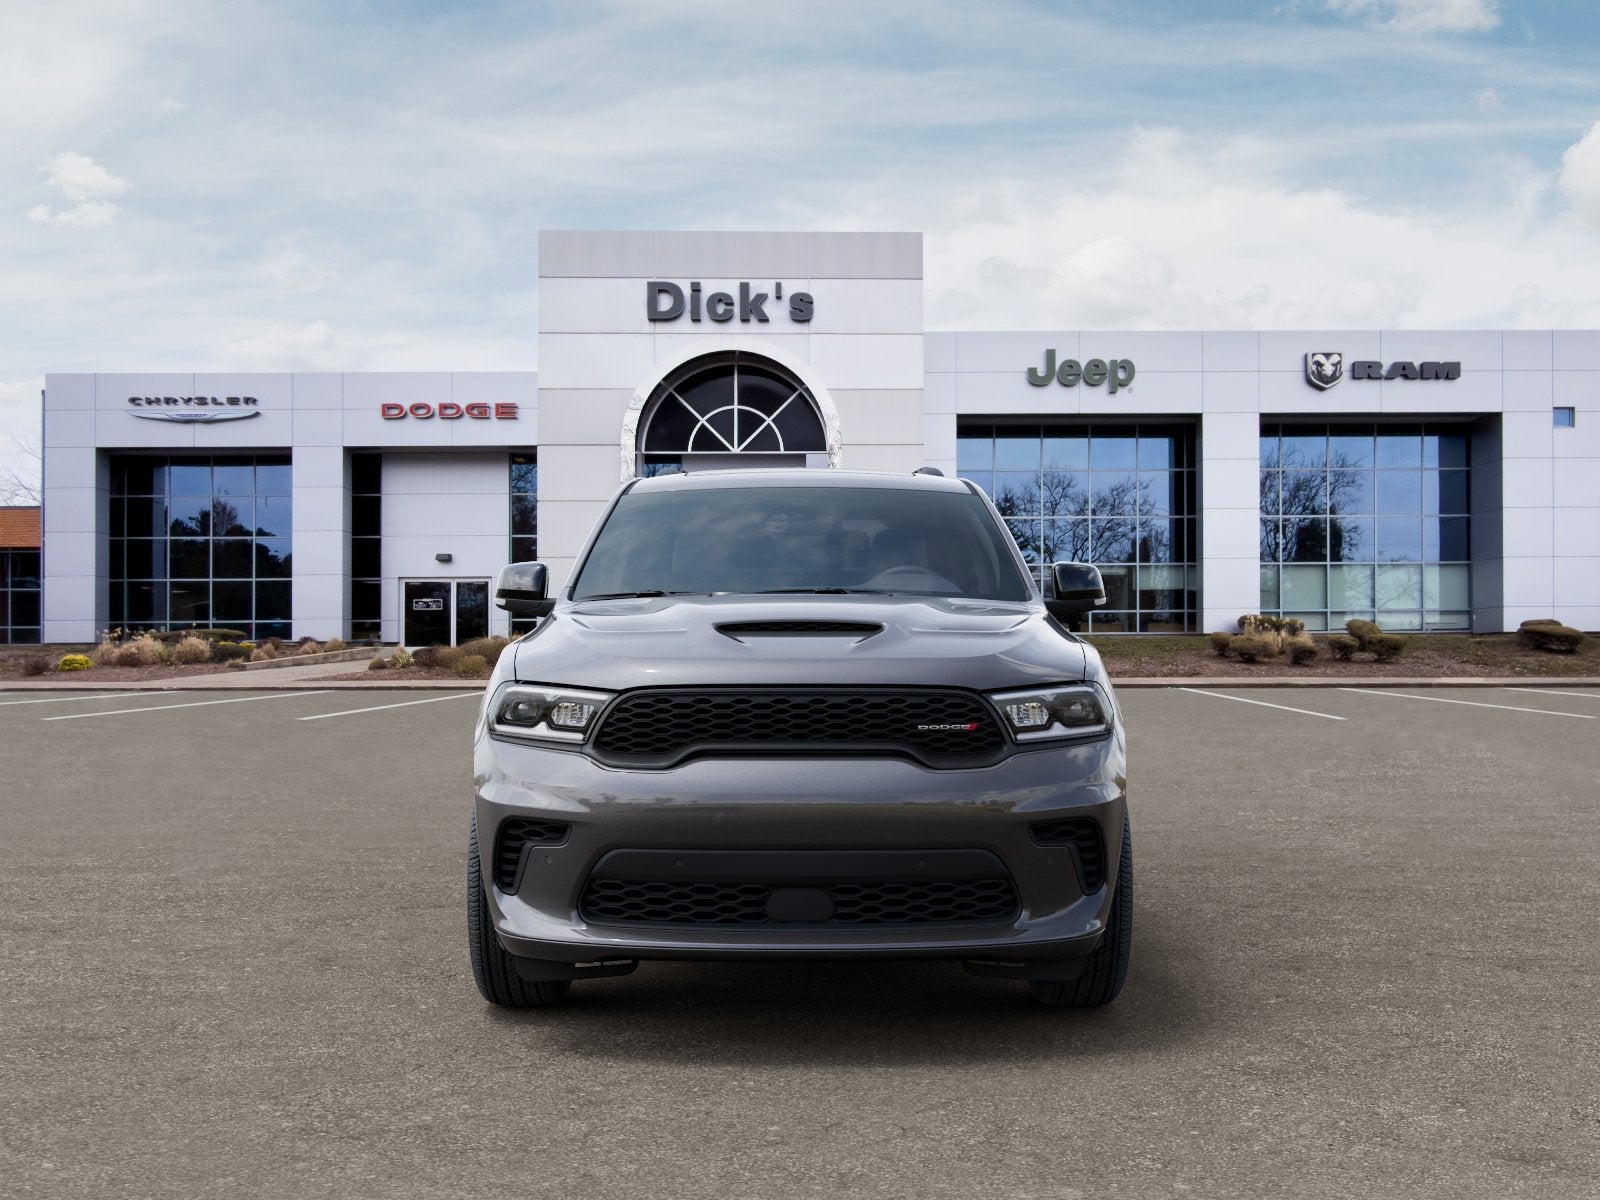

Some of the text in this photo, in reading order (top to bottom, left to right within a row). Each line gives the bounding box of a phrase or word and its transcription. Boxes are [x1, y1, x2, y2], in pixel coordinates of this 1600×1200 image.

[647, 281, 814, 322] Dick's
[1027, 349, 1136, 394] Jeep
[1352, 361, 1461, 380] RAM
[128, 396, 258, 407] CHRYSLER
[381, 403, 518, 420] DODGE
